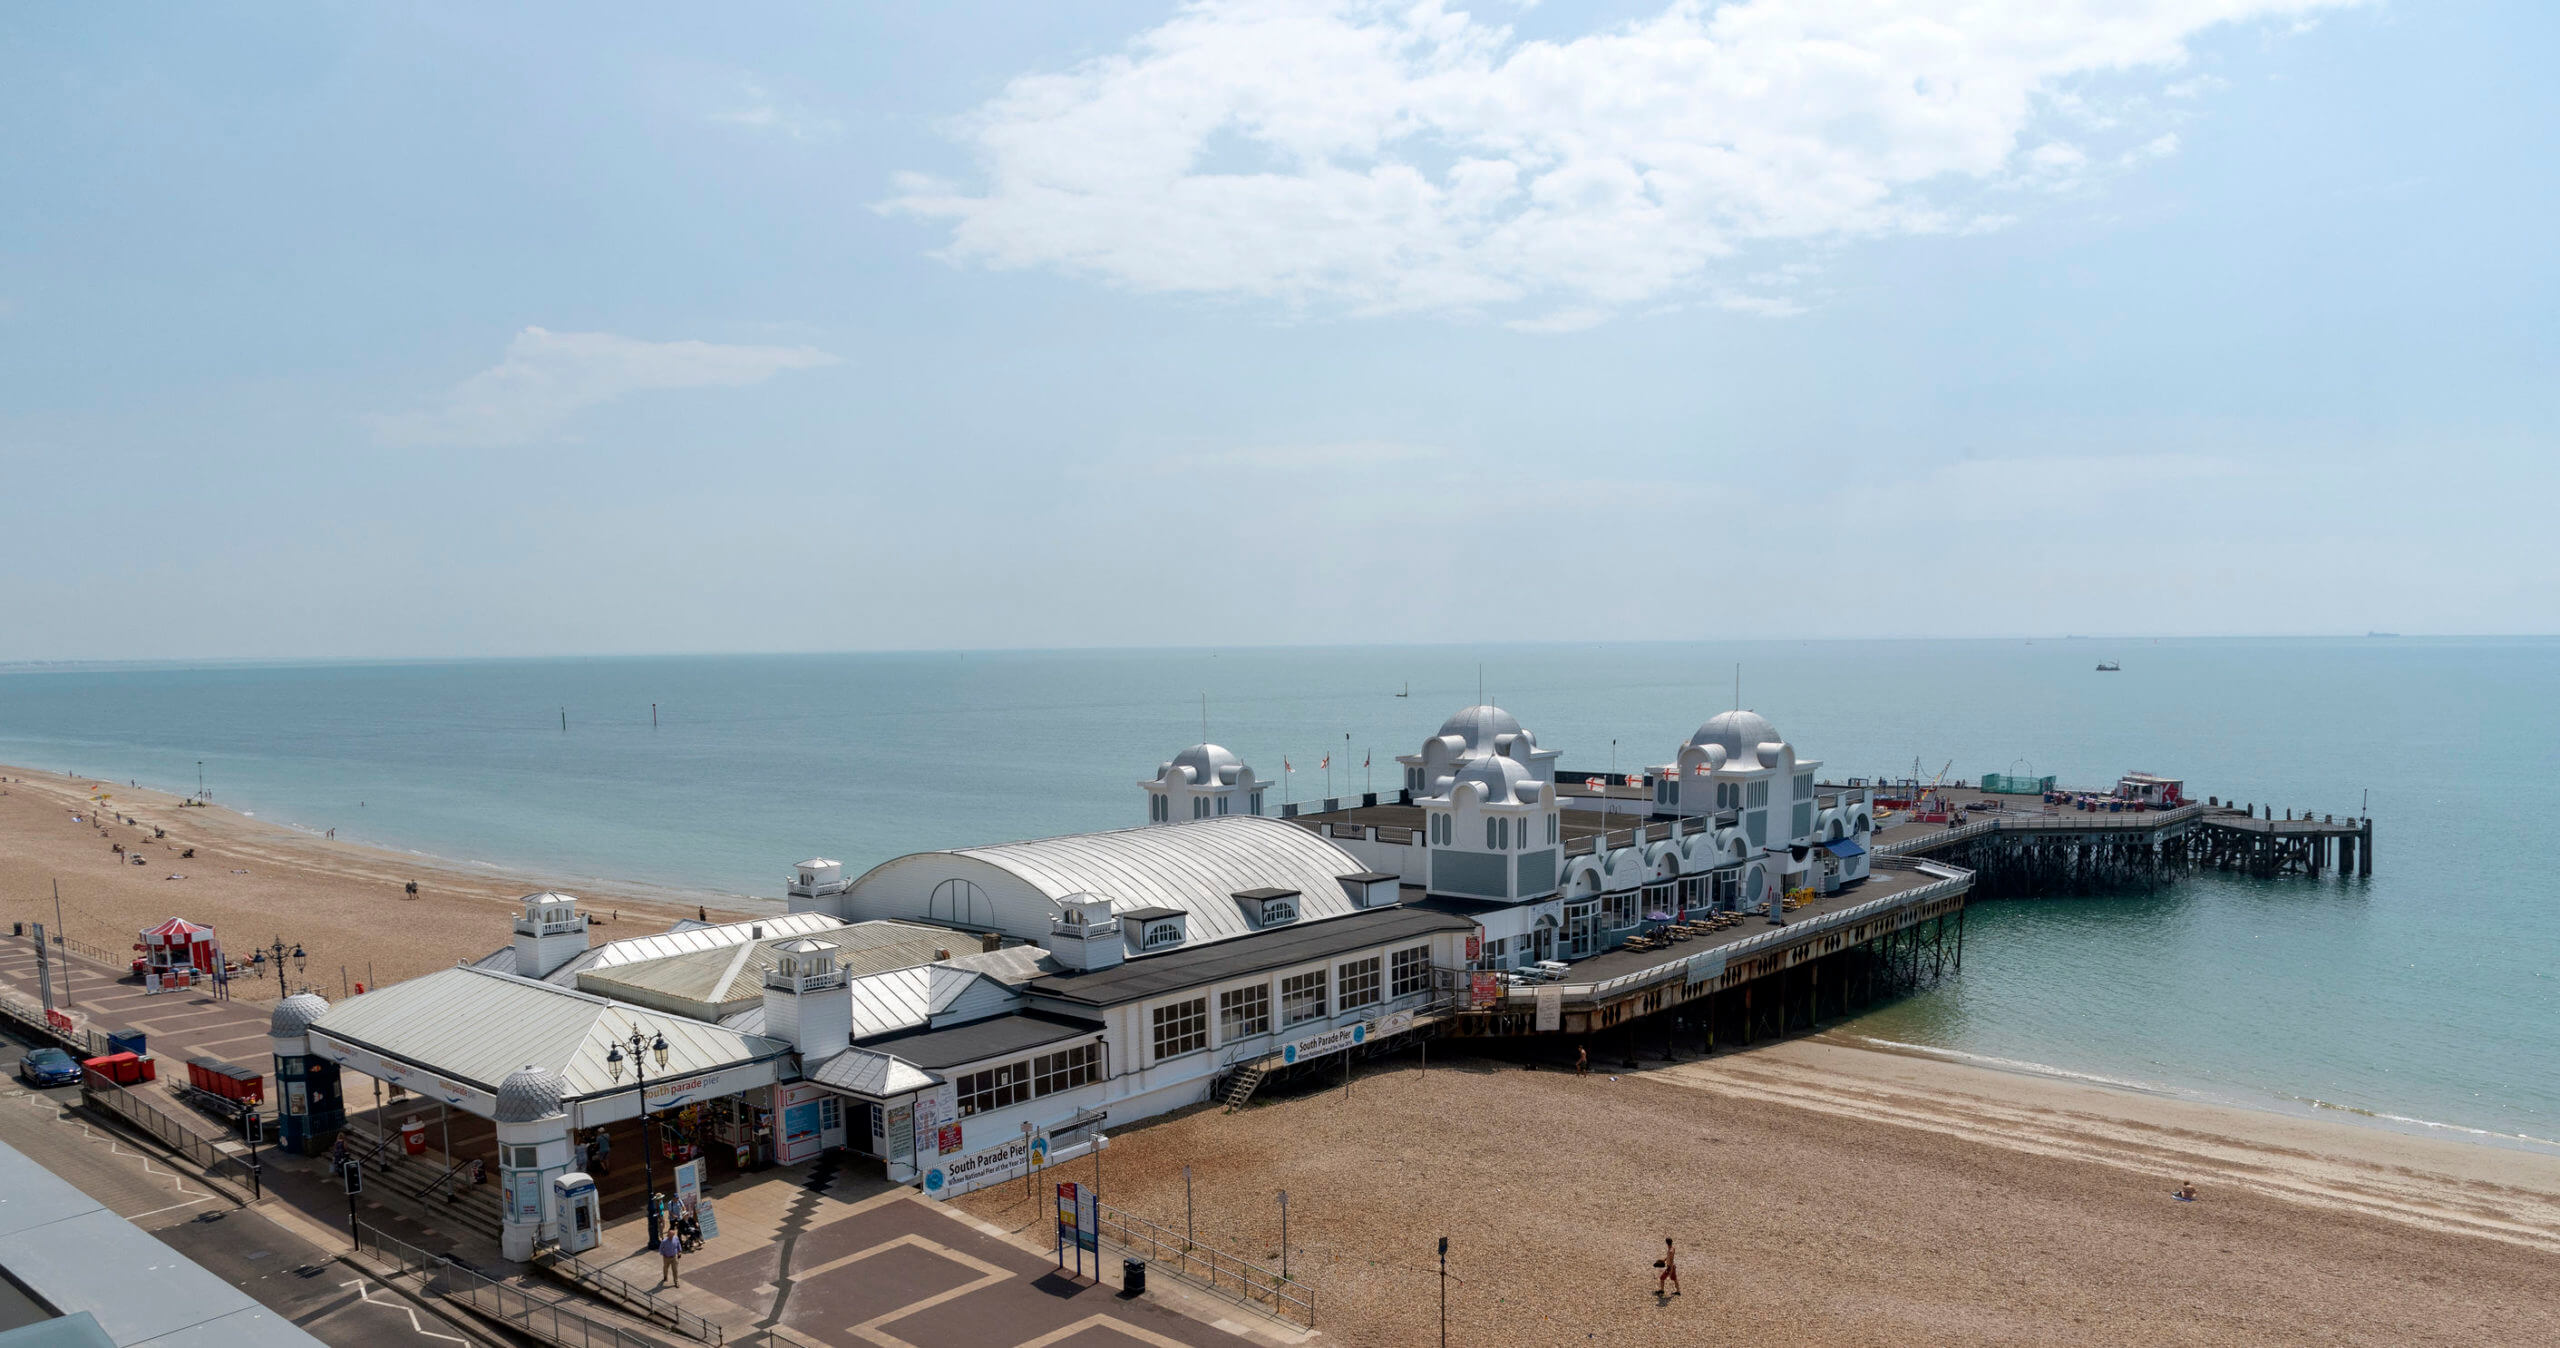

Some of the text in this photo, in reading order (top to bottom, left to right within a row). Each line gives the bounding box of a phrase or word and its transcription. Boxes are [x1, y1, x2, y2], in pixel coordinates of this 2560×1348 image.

[1300, 1039, 1317, 1052] South
[1318, 1033, 1338, 1046] Parade
[1340, 1030, 1351, 1040] Pier
[643, 1076, 719, 1099] south parade pier
[949, 1145, 1026, 1176] South Parade Pier
